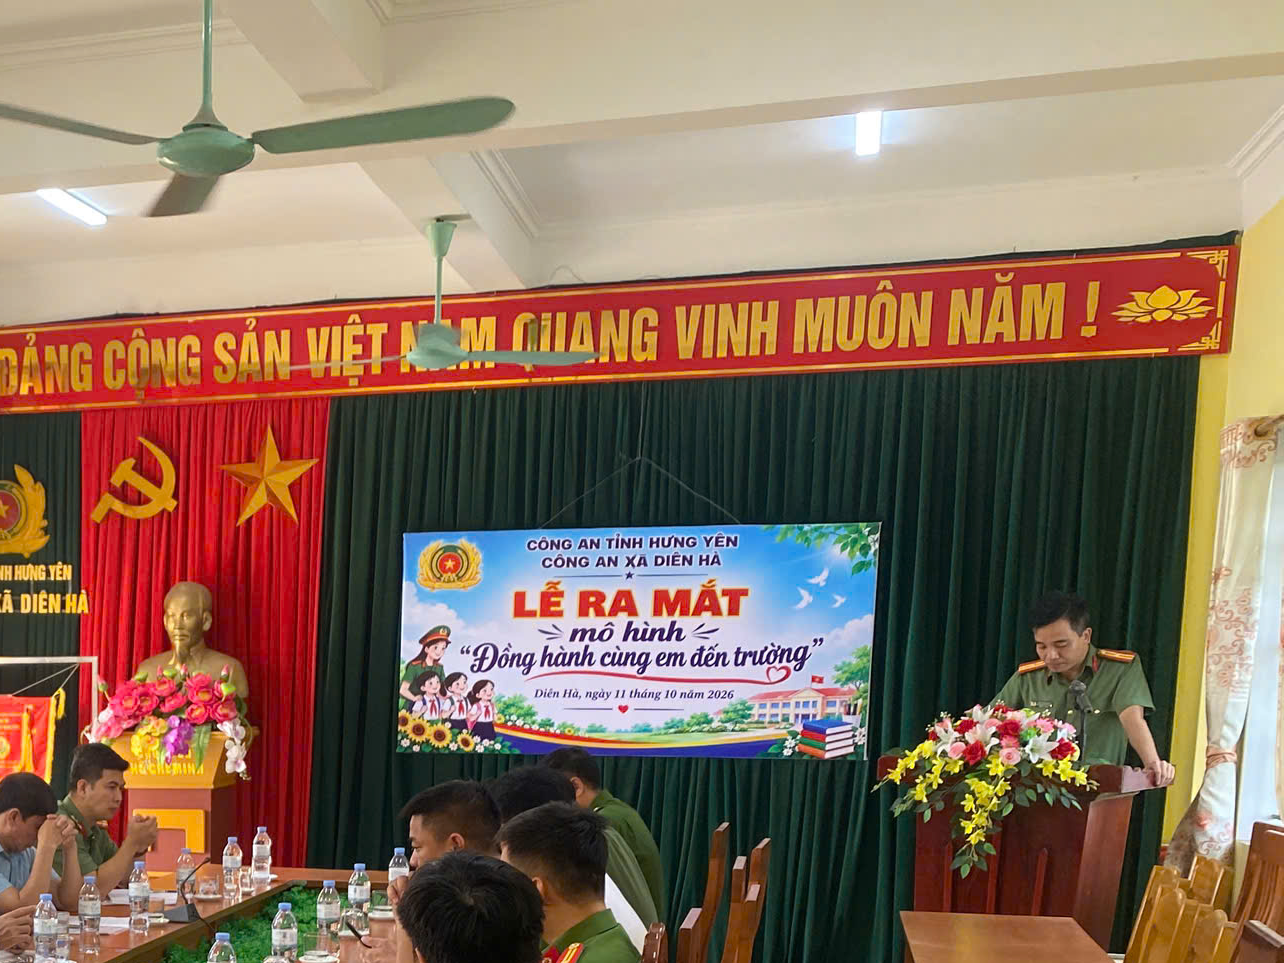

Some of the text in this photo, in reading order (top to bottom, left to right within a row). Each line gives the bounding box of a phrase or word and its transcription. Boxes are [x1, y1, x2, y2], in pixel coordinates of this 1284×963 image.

[103, 328, 202, 400] CỘNG
[213, 318, 291, 384] SẢN
[307, 314, 388, 386] VIỆT
[400, 316, 496, 373] NM
[675, 300, 779, 359] VINH
[793, 280, 933, 354] MUÔN
[948, 272, 1066, 346] NĂM
[1080, 281, 1101, 338] !
[527, 533, 739, 551] CÔNG AN TỈNH HƯNG YÊN
[48, 561, 72, 581] YÊN
[541, 551, 722, 569] CÔNG AN XÃ DIÊN HÀ
[21, 590, 61, 614] DIÊN
[65, 589, 89, 614] HÀ
[513, 577, 749, 618] LỄ RA MẮT
[569, 620, 686, 643] mô hình
[539, 645, 596, 668] hành
[600, 645, 652, 675] cùng
[655, 650, 687, 668] em
[690, 643, 730, 668] đến
[585, 688, 612, 700] ngày
[615, 689, 625, 699] 11
[629, 688, 661, 701] tháng
[665, 689, 677, 699] 10
[680, 689, 704, 699] năm
[707, 689, 735, 700] 2026
